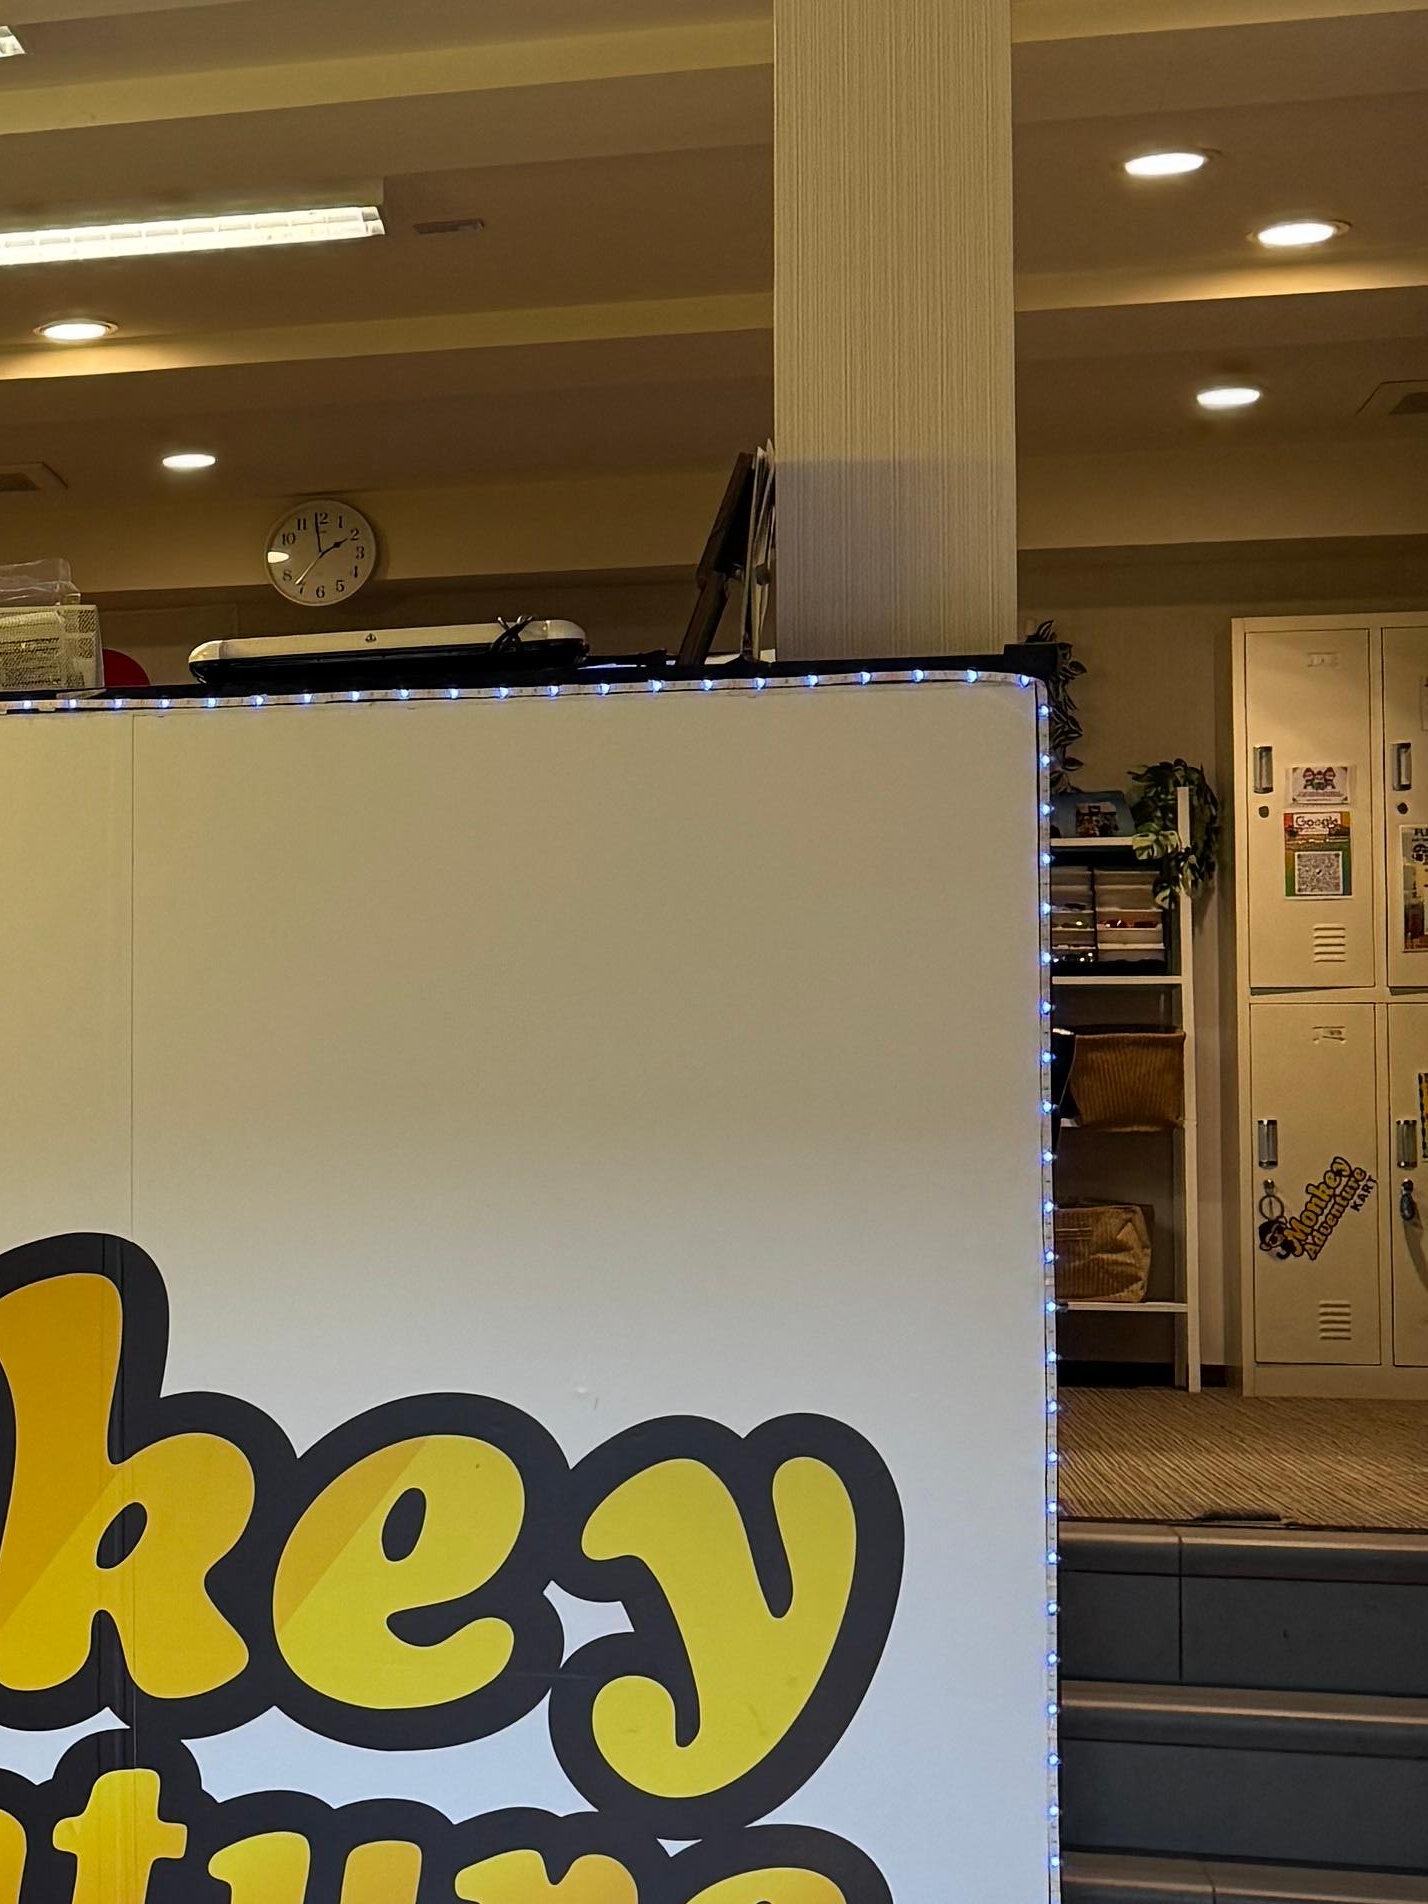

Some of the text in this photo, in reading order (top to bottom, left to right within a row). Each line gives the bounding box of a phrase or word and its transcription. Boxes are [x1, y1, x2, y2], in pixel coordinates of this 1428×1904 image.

[282, 533, 296, 545] 10
[350, 528, 359, 540] 2
[356, 546, 364, 559] 3
[316, 585, 325, 598] 6
[336, 580, 344, 592] 5
[1295, 815, 1339, 828] Google
[1350, 1174, 1379, 1213] KART
[1284, 1156, 1352, 1257] Monkey
[1304, 1167, 1367, 1261] Adventure
